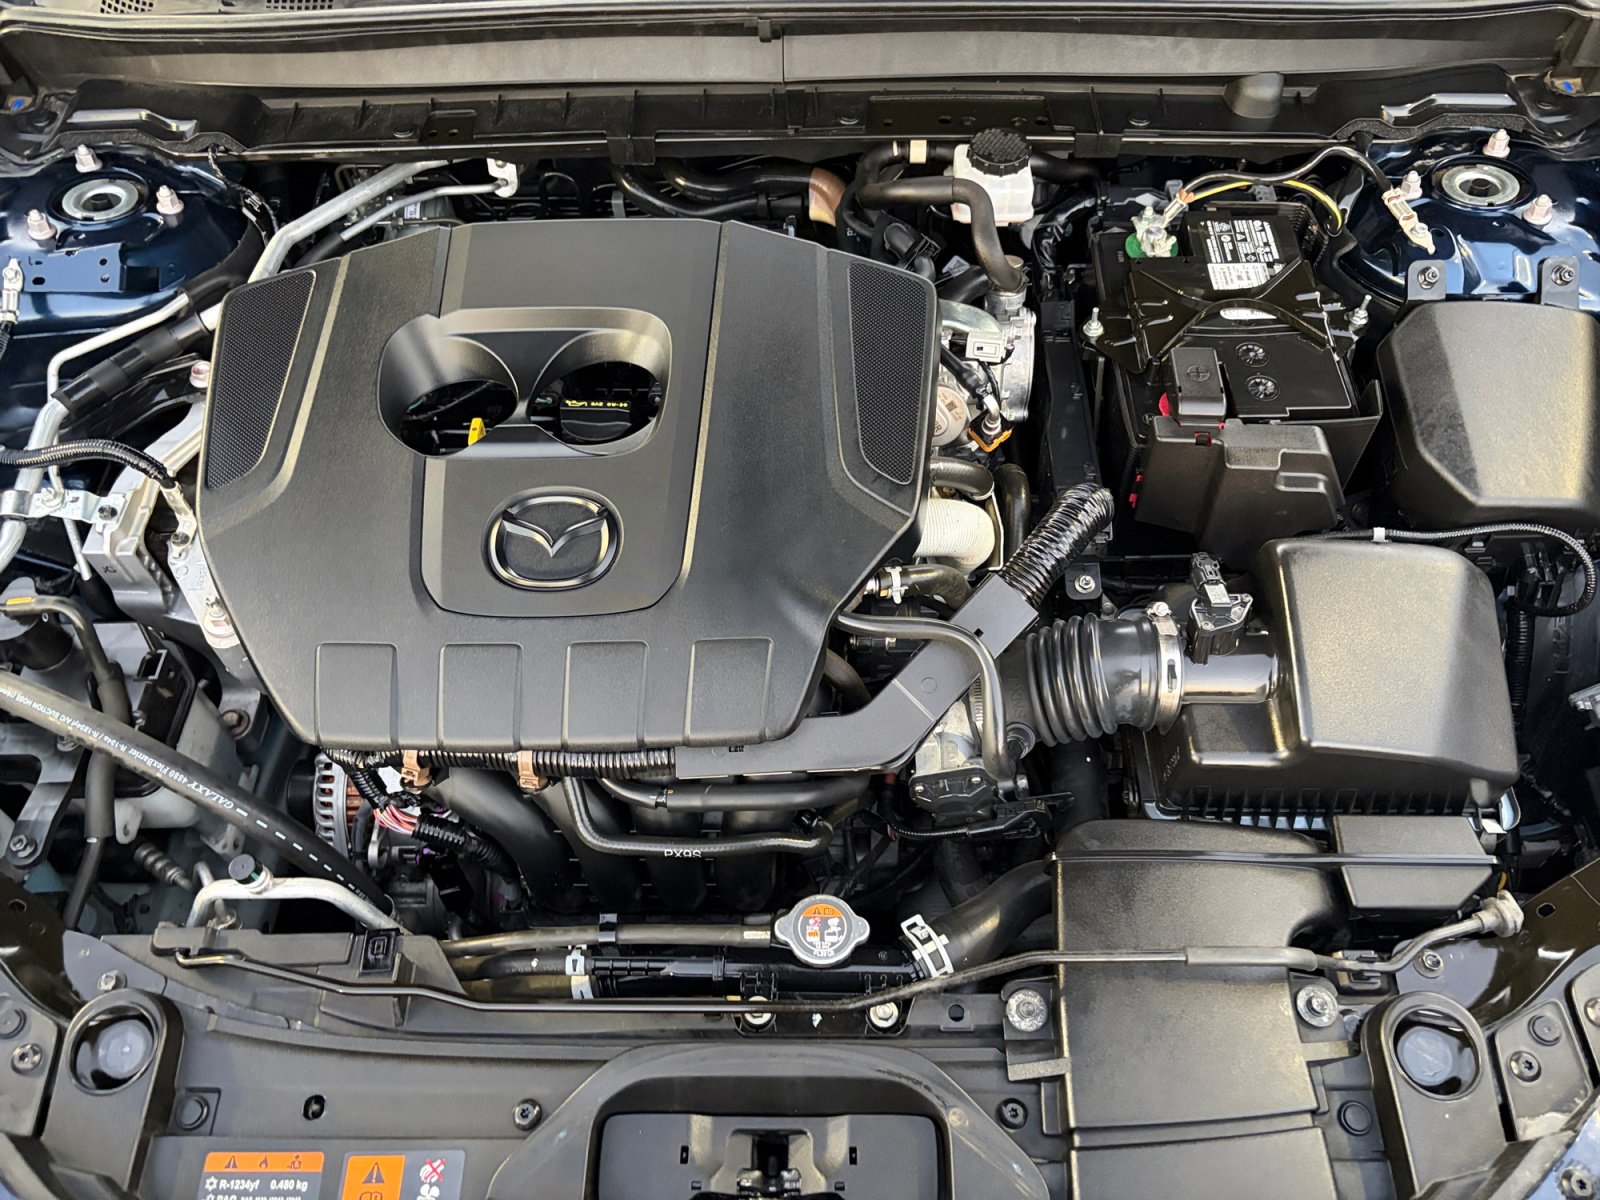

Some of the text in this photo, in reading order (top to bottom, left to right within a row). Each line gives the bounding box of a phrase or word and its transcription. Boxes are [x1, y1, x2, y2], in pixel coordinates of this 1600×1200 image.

[15, 693, 33, 707] HOSE
[32, 702, 61, 719] SUCTION
[71, 719, 100, 738] R-1234yf
[103, 735, 127, 752] R-134a
[128, 747, 170, 775] FlexBarrier
[168, 769, 188, 784] 4880
[187, 780, 235, 809] GALAXY
[219, 1178, 308, 1193] R-1234yf 0.480 kg
